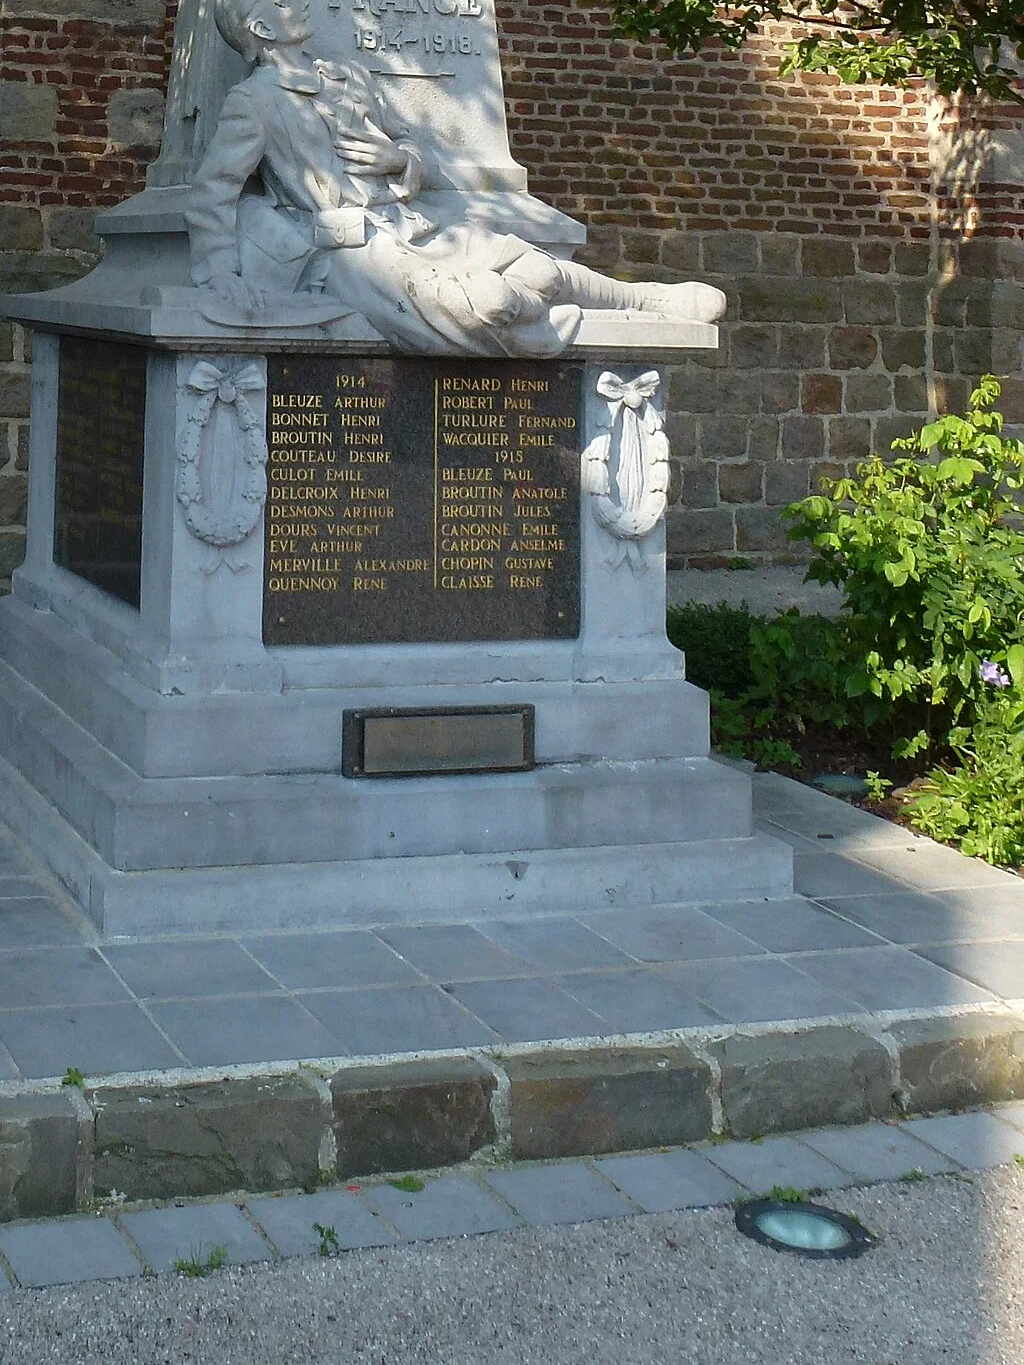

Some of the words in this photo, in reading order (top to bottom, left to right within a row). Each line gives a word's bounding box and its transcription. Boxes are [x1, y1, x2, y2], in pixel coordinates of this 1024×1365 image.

[335, 375, 366, 388] 1914
[442, 378, 501, 391] RENARD
[511, 379, 549, 391] HENRI
[271, 395, 323, 408] BLEUZE
[334, 397, 386, 409] ARTHUR
[442, 396, 494, 409] ROBERT
[504, 397, 534, 409] PAUL
[271, 413, 329, 426] BONNET
[341, 414, 381, 427] HENRI
[442, 414, 507, 427] TURLURE
[518, 416, 576, 428] FERNAND
[271, 431, 333, 444] BROUTIN
[344, 433, 384, 445] HENRI
[442, 433, 509, 446] WACQUIER
[519, 434, 555, 446] EMILE
[271, 451, 336, 463] COUTEAU
[494, 451, 524, 463] 1915
[270, 468, 317, 481] CULOT
[326, 469, 364, 481] EMILE
[441, 468, 493, 480] BLEUZE
[503, 469, 534, 481] PAUL
[271, 487, 339, 500] DELCROIX
[350, 487, 390, 500] HENRI
[441, 486, 503, 499] BROUTIN
[512, 487, 568, 499] ANATOLE
[270, 505, 334, 518] DESMONS
[343, 507, 395, 518] ARTHUR
[441, 505, 503, 518] BROUTIN
[514, 505, 551, 517] JULES
[270, 524, 317, 537] DOURS
[328, 525, 380, 536] VINCENT
[441, 523, 511, 536] CANONNE
[522, 523, 558, 536] EMILE
[269, 540, 297, 553] EVE
[310, 541, 362, 553] ARTHUR
[441, 539, 501, 552] CARDON
[510, 539, 566, 551] ANSELME
[269, 559, 342, 572] MERVILLE
[354, 559, 429, 571] ALEXANDRE
[441, 557, 494, 570] CHOPIN
[505, 557, 554, 570] GUSTAVE
[269, 578, 340, 591] QUENNOY
[441, 576, 495, 589] CLAISSE
